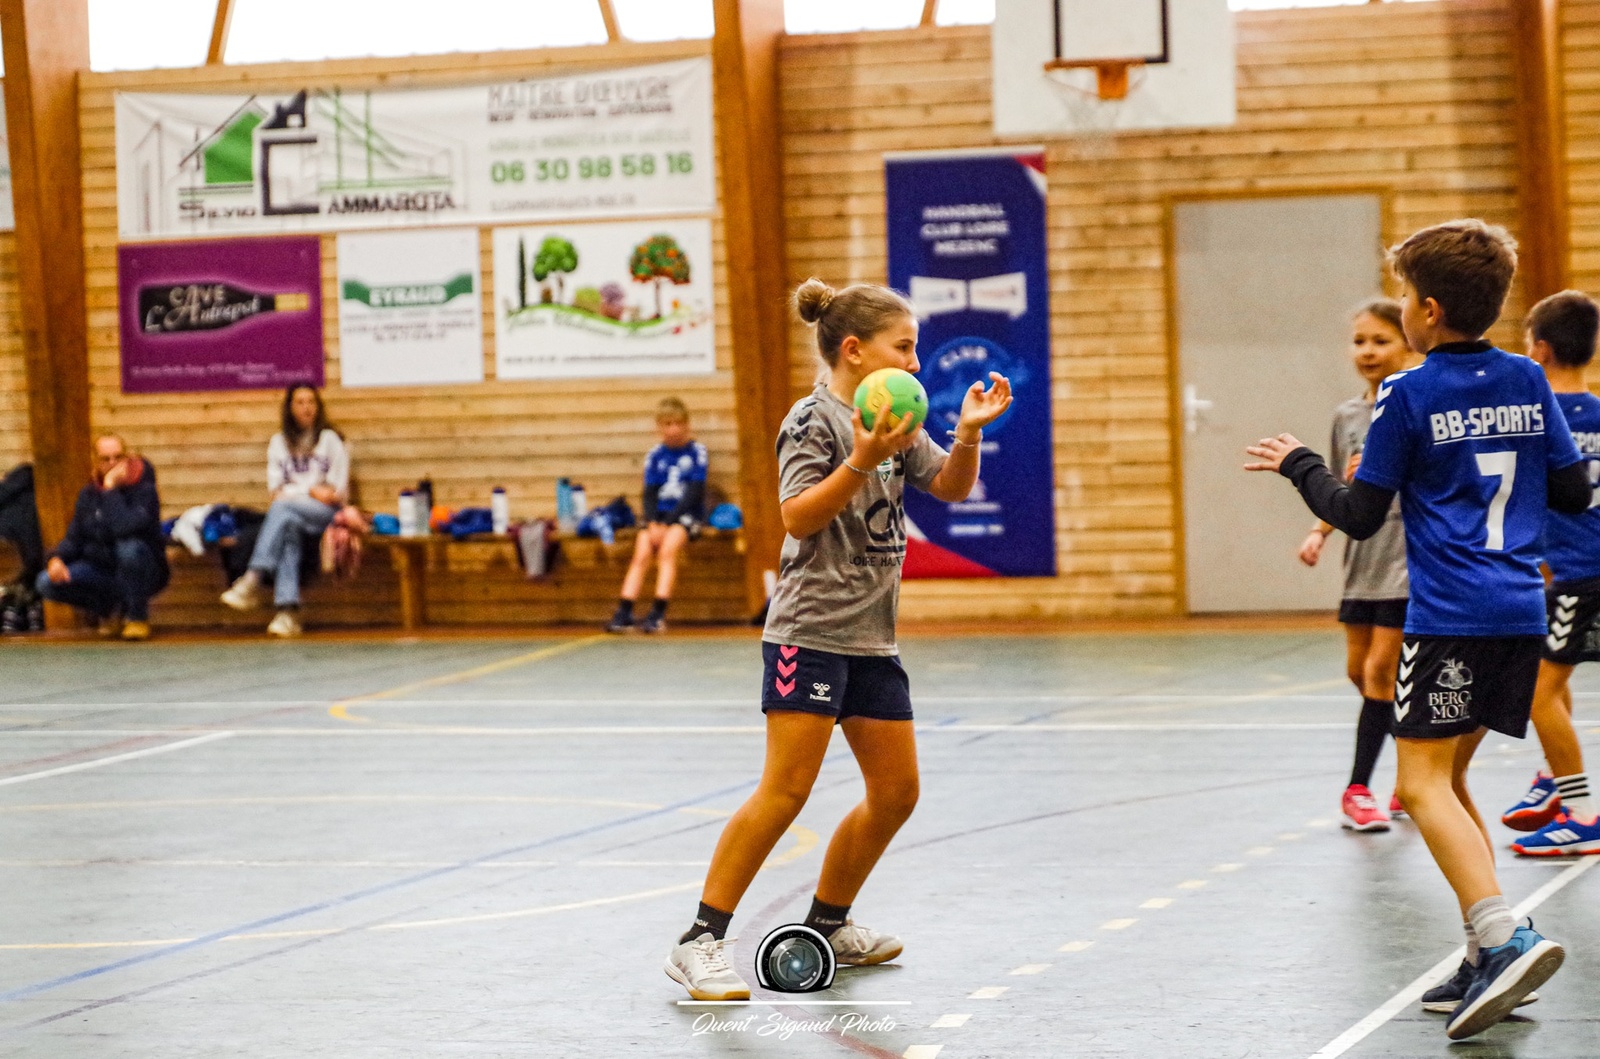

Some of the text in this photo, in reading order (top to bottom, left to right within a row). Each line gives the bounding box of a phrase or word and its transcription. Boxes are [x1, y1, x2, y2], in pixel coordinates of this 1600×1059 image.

[491, 160, 524, 183] 06
[535, 158, 569, 180] 30
[621, 153, 655, 176] 58
[1430, 403, 1545, 441] BB-SPORTS
[1475, 451, 1518, 551] 7
